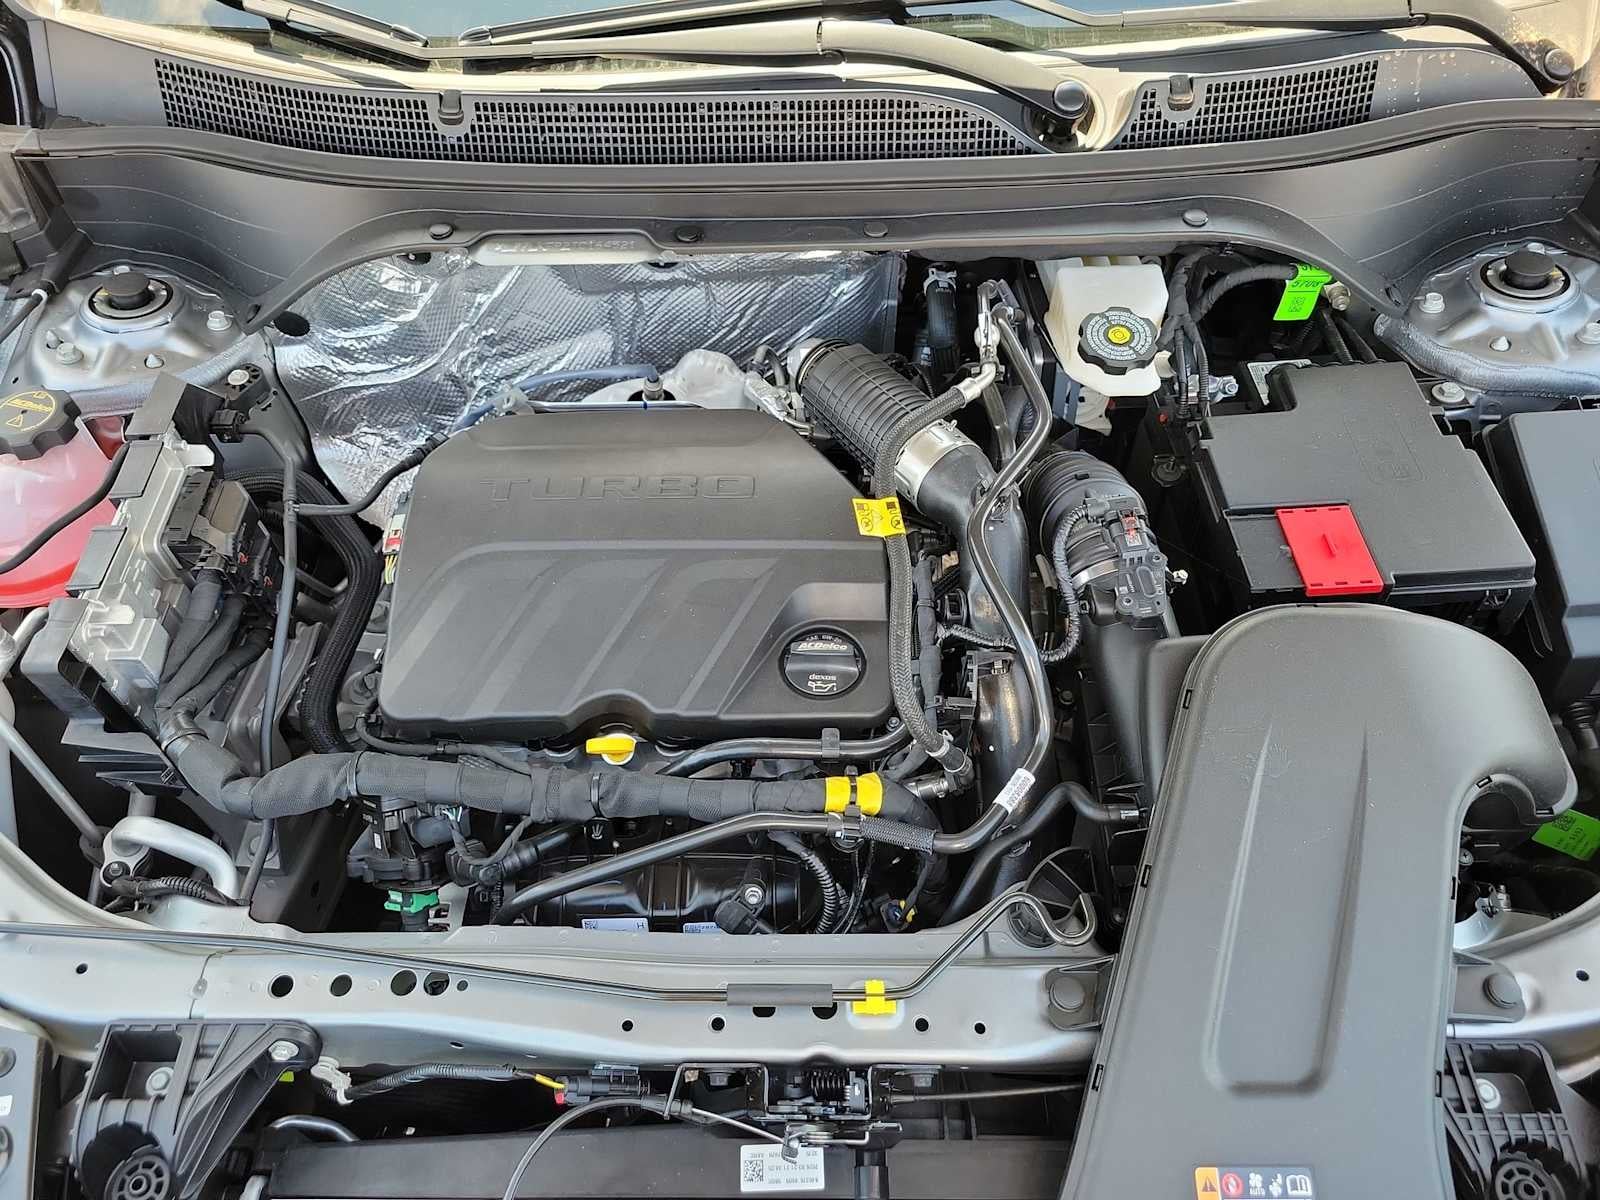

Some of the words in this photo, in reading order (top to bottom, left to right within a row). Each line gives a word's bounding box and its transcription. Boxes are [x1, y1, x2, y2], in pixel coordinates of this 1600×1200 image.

[479, 475, 758, 501] TURBO
[798, 642, 848, 651] ACDelco
[808, 673, 837, 681] dexos
